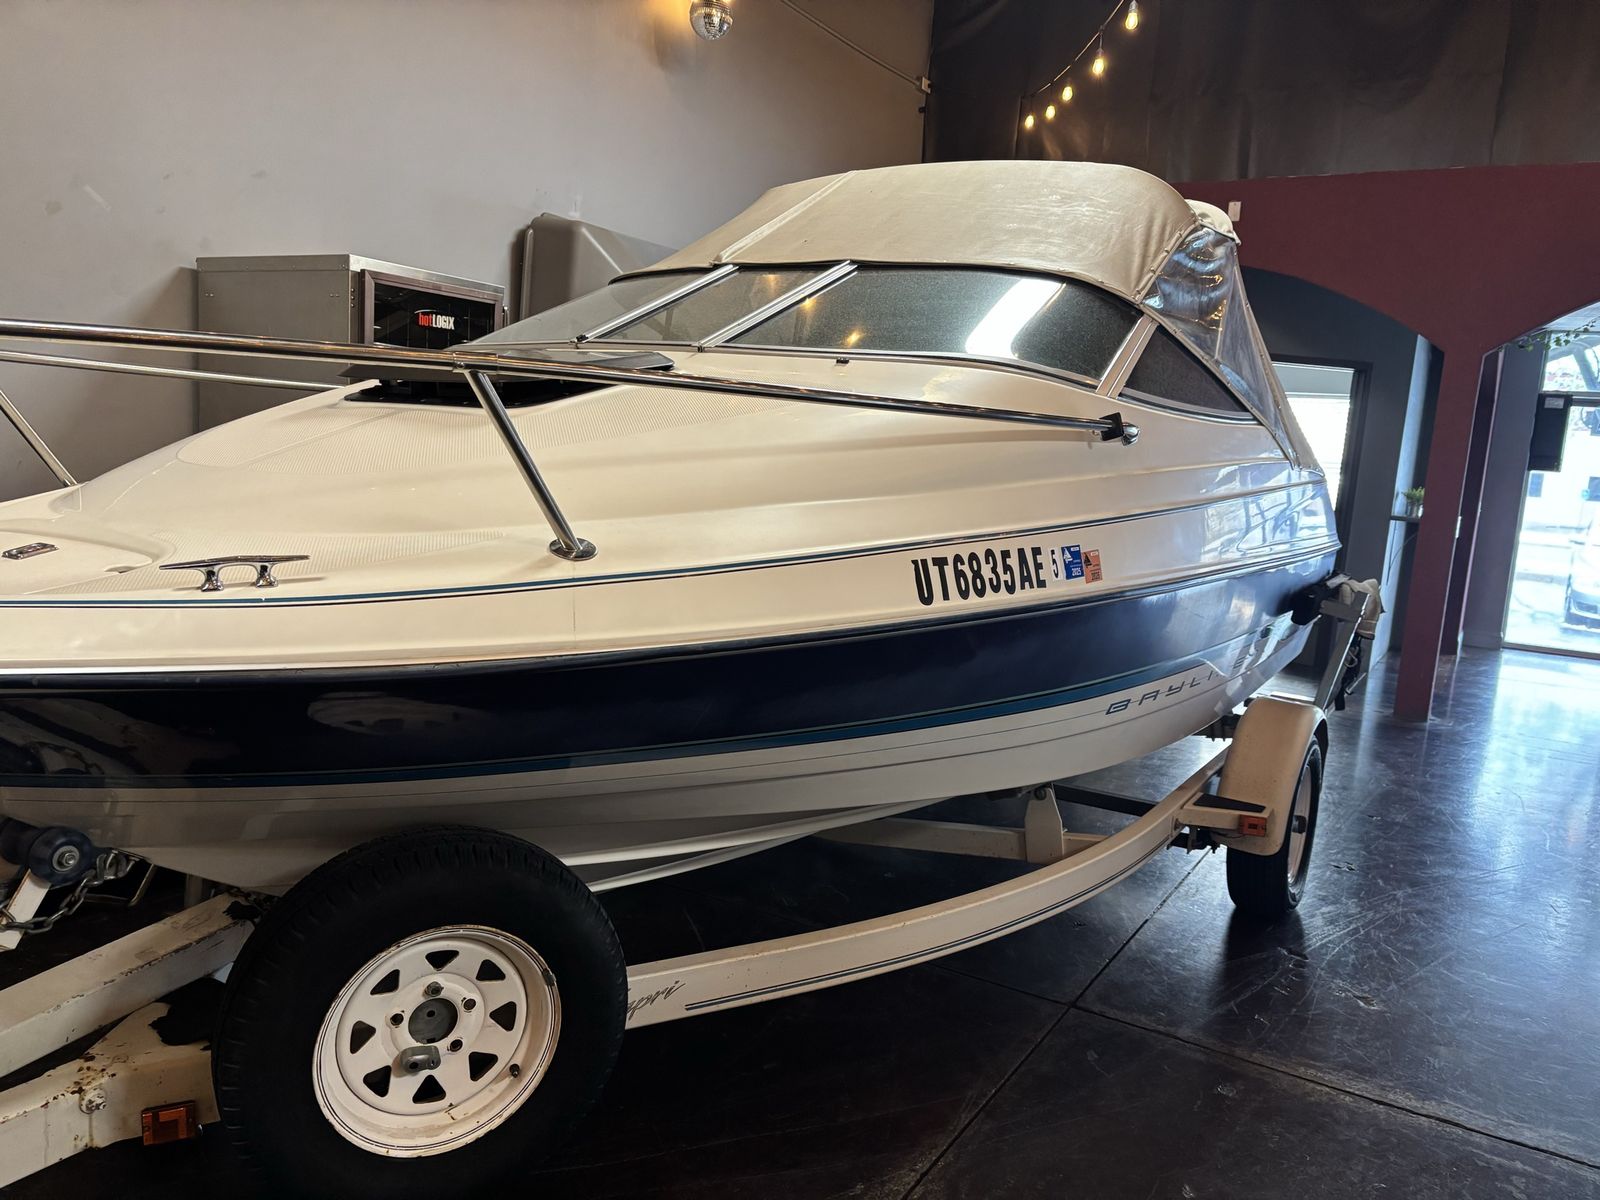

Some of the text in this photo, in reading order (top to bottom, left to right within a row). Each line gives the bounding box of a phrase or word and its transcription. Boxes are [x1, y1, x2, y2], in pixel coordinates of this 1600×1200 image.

[418, 312, 455, 330] hotLOGIX
[911, 547, 1059, 606] UT6835AE 5
